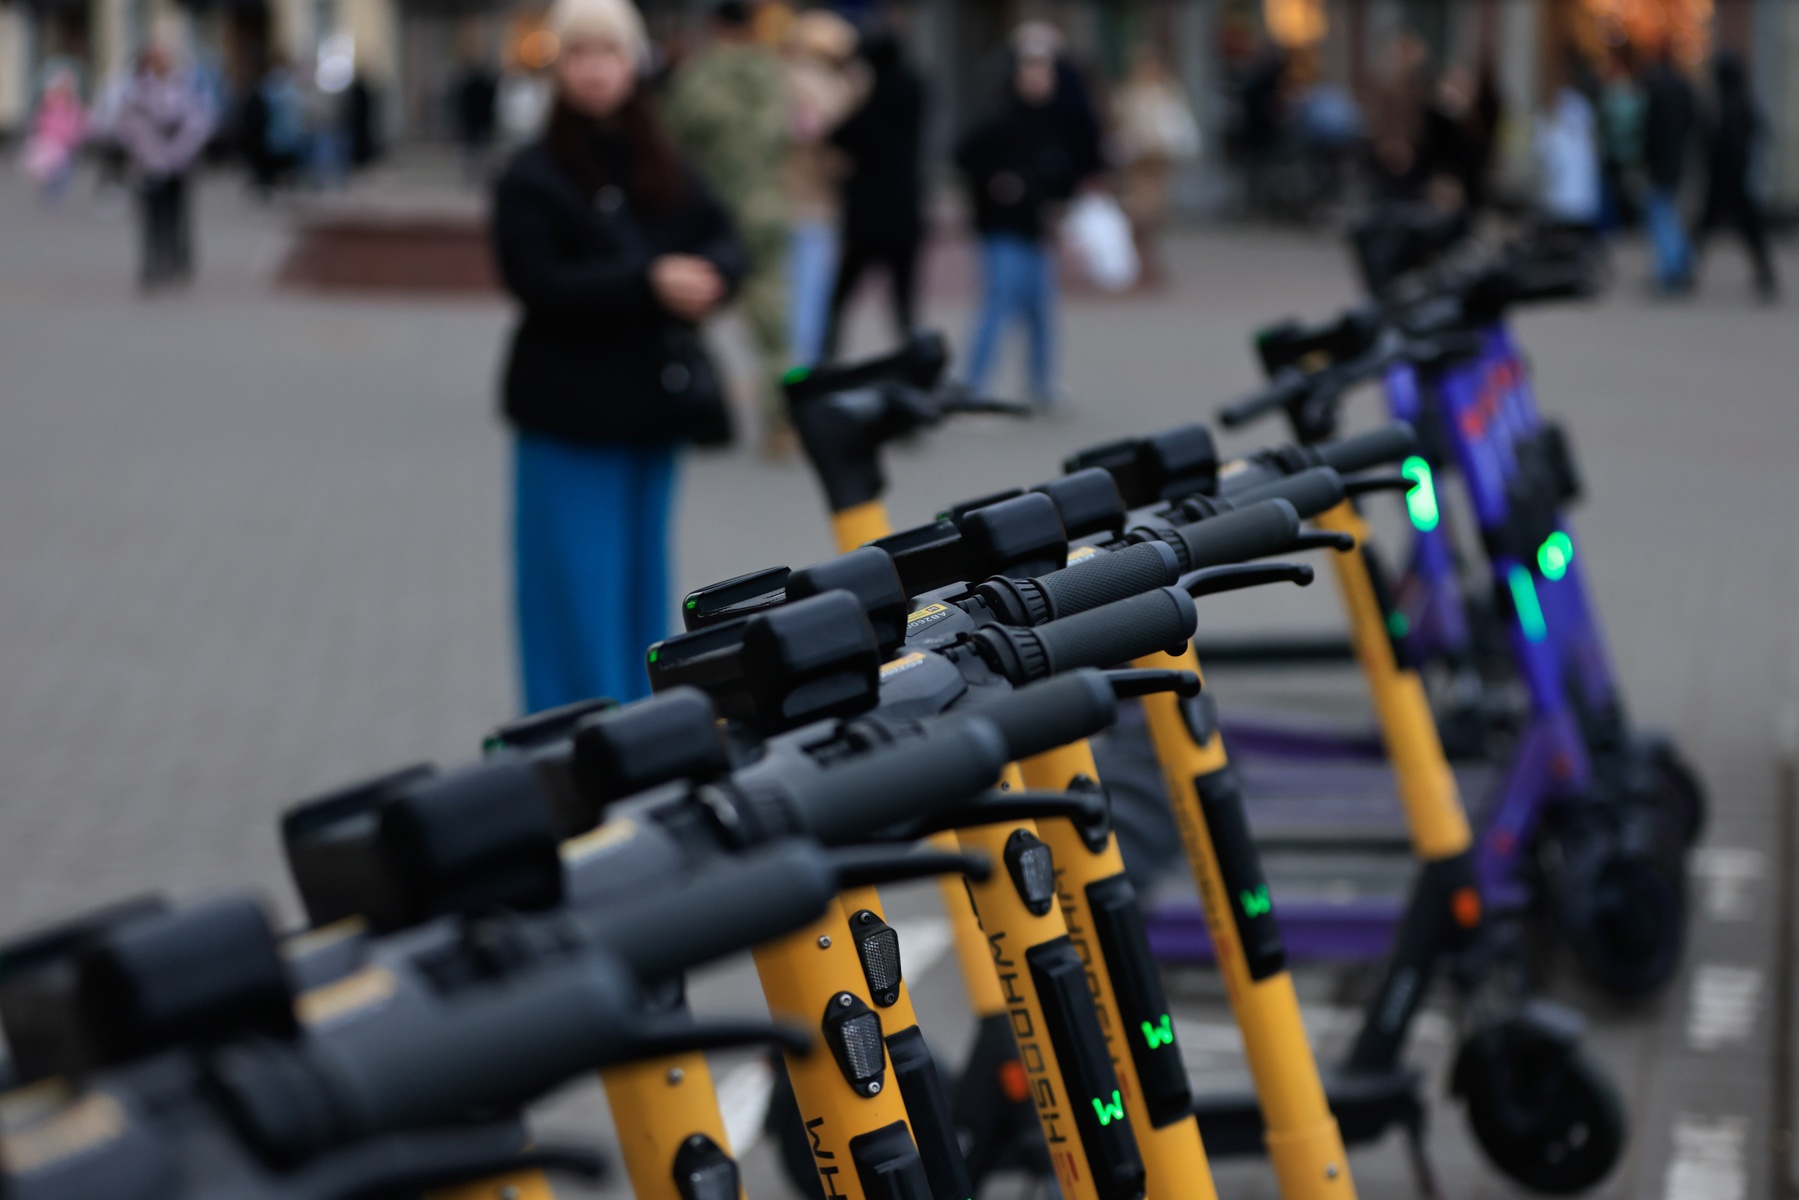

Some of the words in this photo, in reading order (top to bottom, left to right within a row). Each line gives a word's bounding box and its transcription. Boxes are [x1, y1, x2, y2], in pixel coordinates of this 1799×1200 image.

[989, 932, 1067, 1143] WHOOSH
[1141, 1014, 1173, 1049] W
[1092, 1090, 1124, 1125] W
